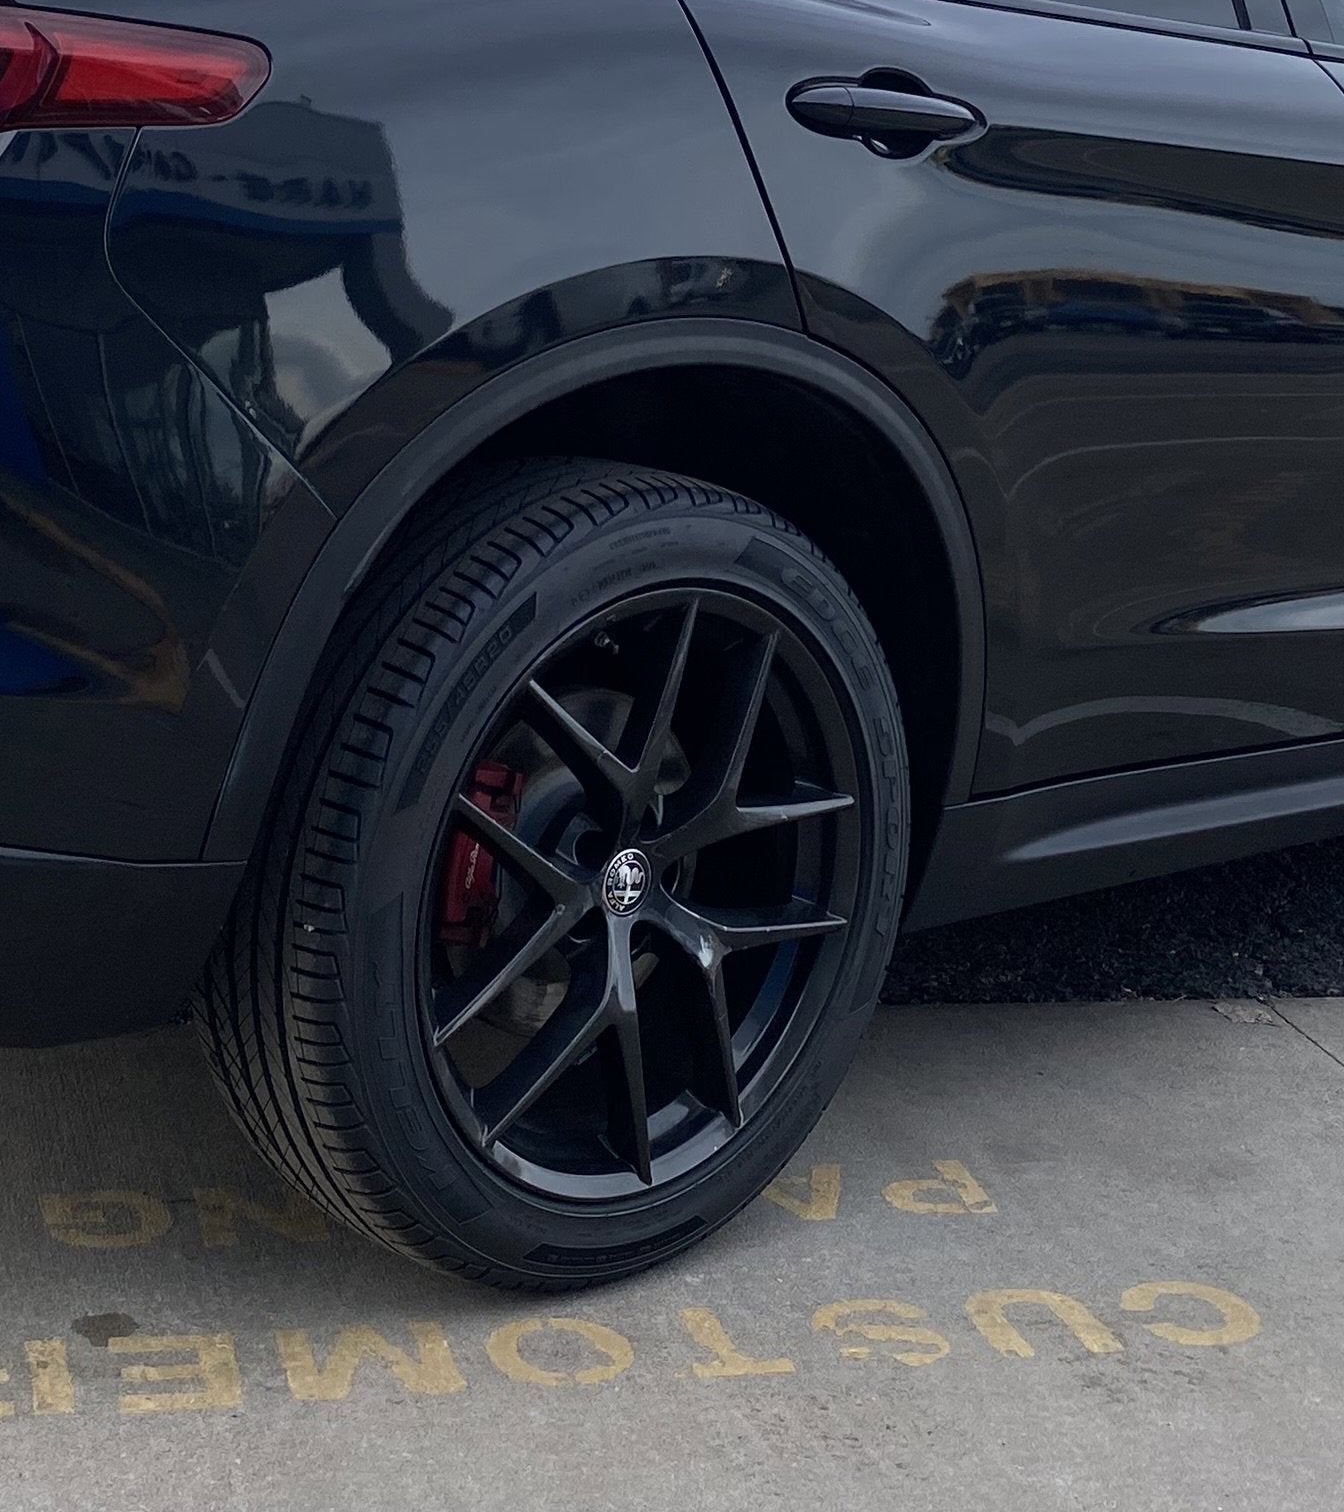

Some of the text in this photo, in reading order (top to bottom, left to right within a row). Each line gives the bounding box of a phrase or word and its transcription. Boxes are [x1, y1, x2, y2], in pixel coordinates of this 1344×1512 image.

[777, 562, 876, 696] EDGE
[606, 852, 634, 912] ALFA ROMEO
